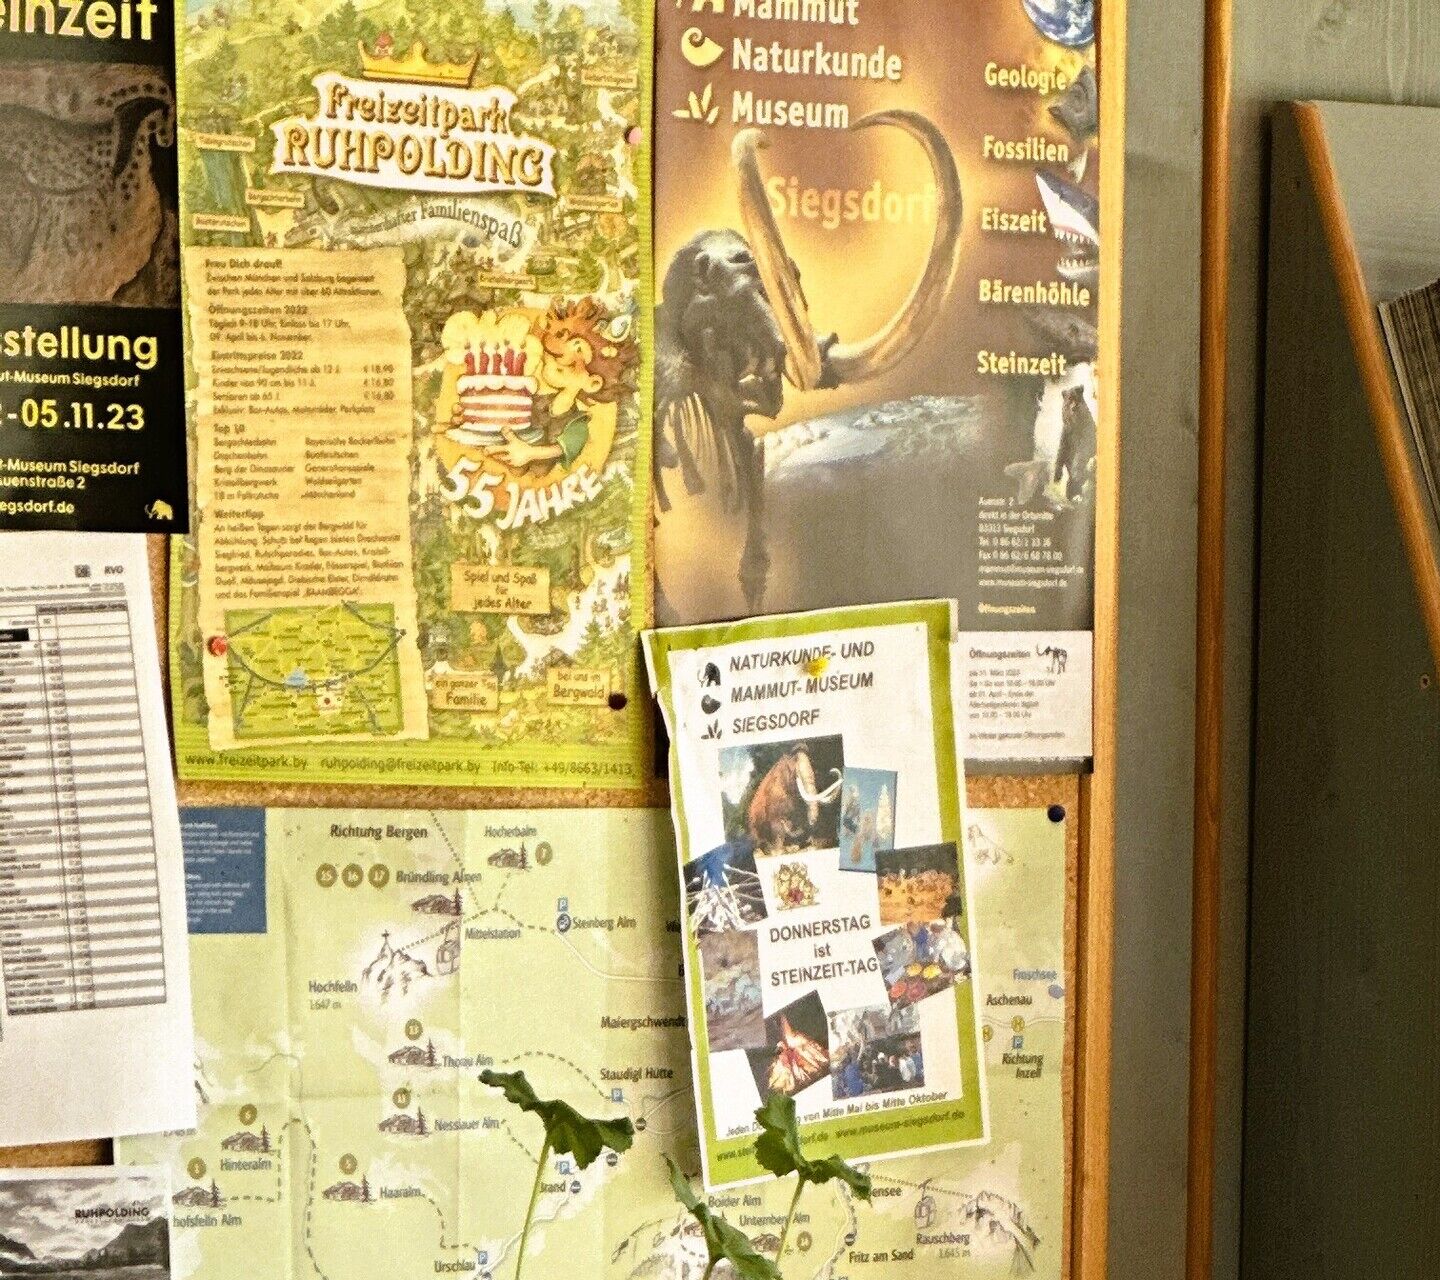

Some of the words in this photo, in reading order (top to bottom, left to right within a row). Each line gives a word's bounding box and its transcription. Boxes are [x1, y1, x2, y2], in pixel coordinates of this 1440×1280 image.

[731, 38, 903, 82] Naturkunde
[985, 61, 1067, 95] Geologie
[325, 82, 511, 138] Freizeitpark
[731, 91, 850, 130] Museum
[282, 125, 545, 187] RUHPOLDING
[983, 136, 1069, 164] Fossilien
[767, 177, 935, 230] Siegsdorf
[420, 198, 522, 249] Familienspaß
[981, 208, 1047, 234] Eiszeit
[979, 279, 1091, 308] Bärenhöhle
[977, 351, 1068, 378] Steinzeit
[72, 371, 140, 389] Siegsdorf
[69, 460, 140, 477] Siegsdorf
[77, 476, 86, 489] 2
[440, 456, 506, 519] 55
[495, 464, 603, 530] JAHRE
[490, 571, 510, 582] und
[473, 598, 501, 611] jedes
[505, 598, 532, 609] Alter
[840, 640, 875, 660] UND
[554, 684, 605, 702] Bergwald
[730, 678, 802, 703] MAMMUT-
[805, 670, 874, 693] MUSEUM
[447, 692, 487, 706] Familie
[732, 709, 820, 735] SIEGSDORF
[184, 752, 308, 771] www.freizeitpark.by
[330, 824, 382, 841] Richtung
[385, 824, 428, 841] Bergen
[572, 917, 614, 931] Steinberg
[617, 916, 637, 928] Alm
[769, 914, 871, 943] DONNERSTAG
[813, 943, 831, 958] ist
[770, 957, 879, 987] STEINZEIT-TAG
[986, 993, 1033, 1008] Aschenau
[1002, 1052, 1043, 1067] Richtung
[1015, 1066, 1042, 1079] Inzell
[823, 1105, 845, 1118] Mitte
[866, 1099, 880, 1112] bis
[882, 1096, 906, 1109] Mitte
[908, 1090, 948, 1107] Oktober
[726, 1123, 751, 1137] Jeden
[220, 1157, 271, 1170] Hinteralm
[74, 1206, 149, 1219] RUHPOLDING
[916, 1233, 971, 1248] Rauschberg
[849, 1250, 870, 1263] Fritz
[873, 1251, 888, 1262] am
